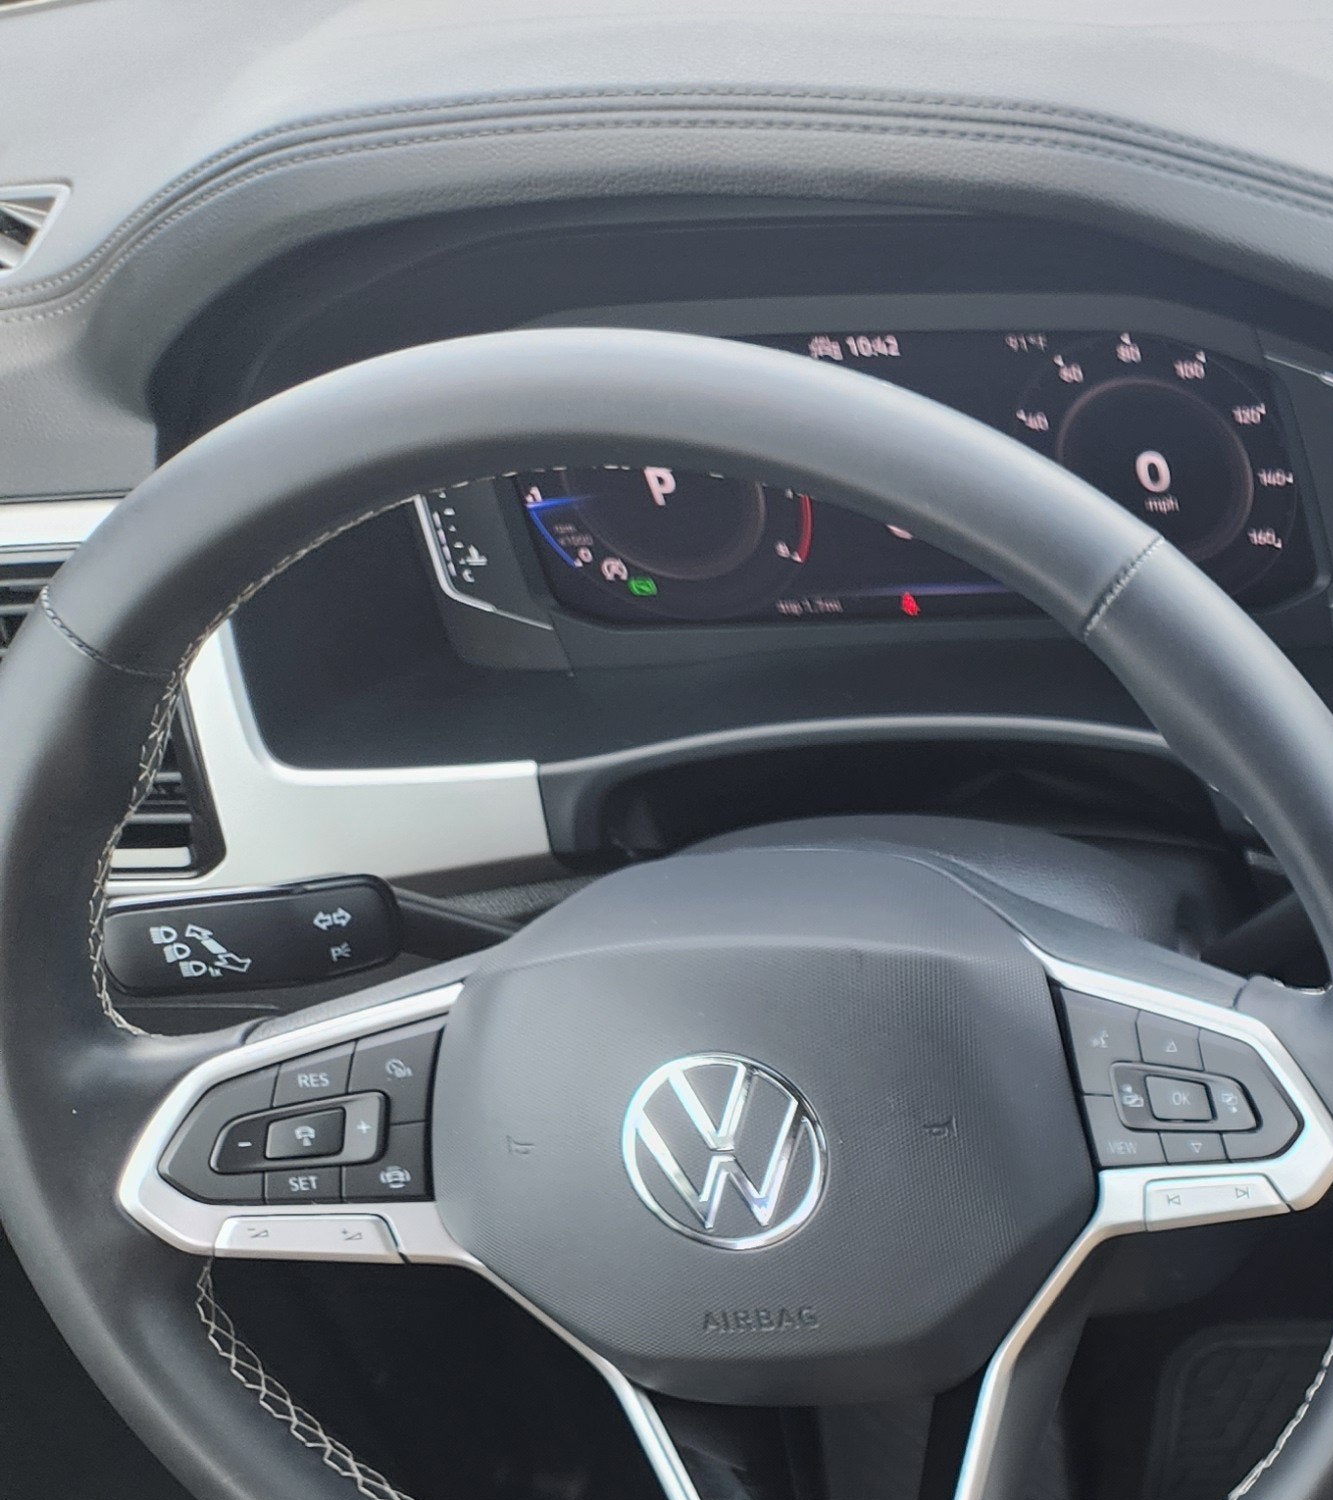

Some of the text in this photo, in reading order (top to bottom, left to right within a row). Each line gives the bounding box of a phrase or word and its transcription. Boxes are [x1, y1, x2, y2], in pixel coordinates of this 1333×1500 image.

[845, 334, 901, 357] 10:42
[1135, 450, 1171, 493] 0
[643, 466, 677, 506] P
[1145, 495, 1180, 514] mph
[297, 1072, 330, 1089] RES
[1171, 1092, 1191, 1106] OK
[1107, 1141, 1137, 1155] VIEW
[288, 1175, 319, 1193] SET
[702, 1306, 820, 1333] AIRBAG
